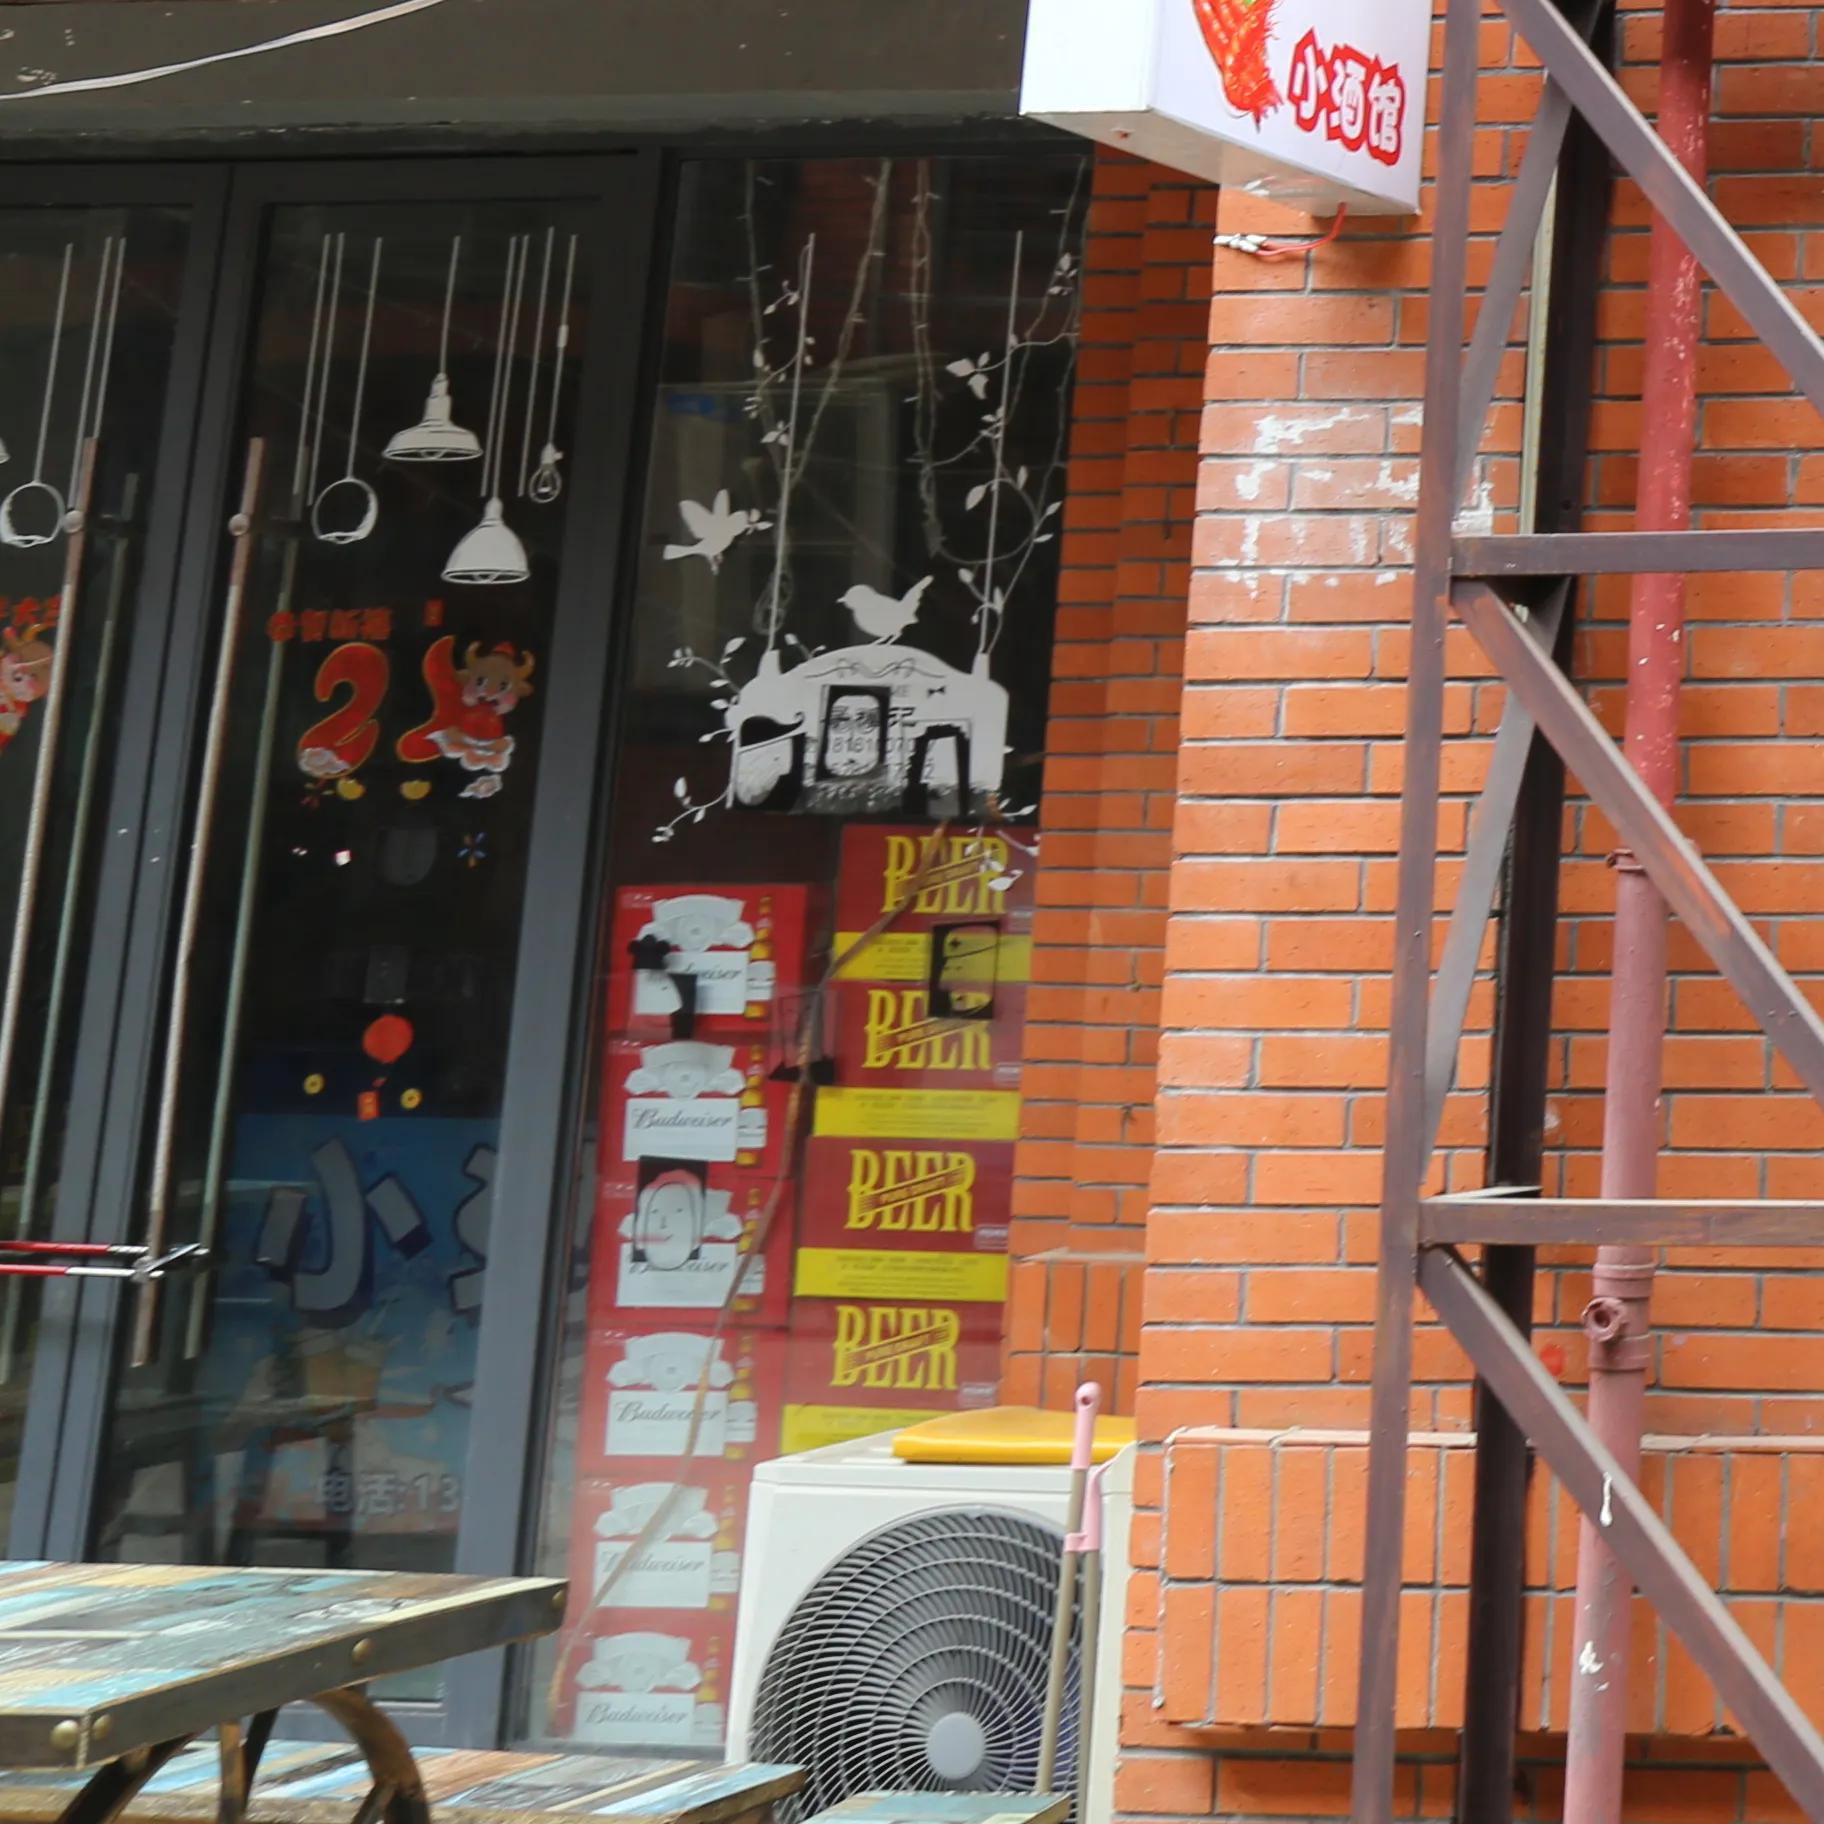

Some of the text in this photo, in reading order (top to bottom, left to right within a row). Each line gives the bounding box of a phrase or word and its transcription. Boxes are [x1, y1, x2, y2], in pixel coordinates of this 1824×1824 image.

[880, 835, 1009, 914] BEER
[632, 1108, 733, 1132] Budweiser
[844, 1149, 977, 1232] BEER
[830, 1305, 960, 1390] BEER
[616, 1399, 721, 1422] Budweier
[585, 1702, 688, 1725] Budweiser
